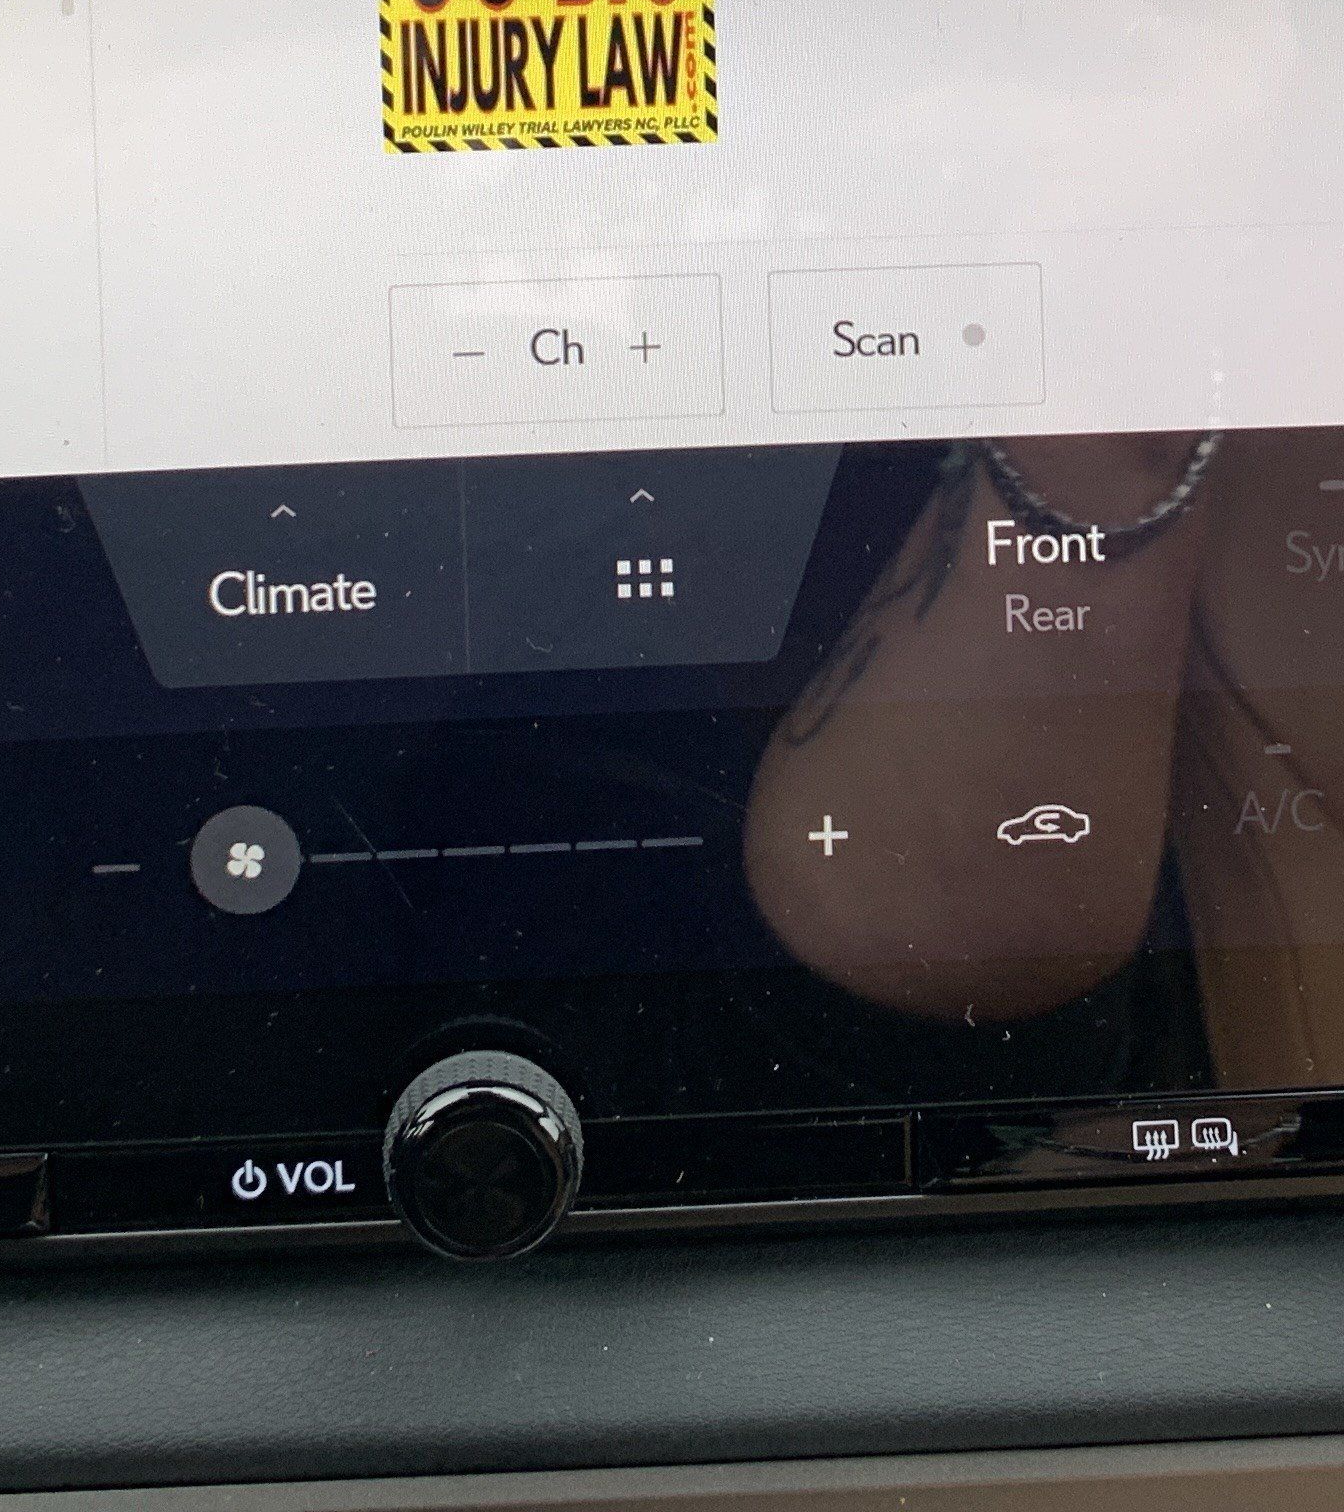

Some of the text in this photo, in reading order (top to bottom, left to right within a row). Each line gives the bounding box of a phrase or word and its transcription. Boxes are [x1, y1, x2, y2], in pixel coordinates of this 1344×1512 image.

[400, 11, 685, 116] INJURY LAW
[401, 124, 457, 138] POULIN
[461, 122, 516, 137] WILLEY
[518, 120, 559, 135] TRIAL
[563, 118, 632, 133] LAWYERS
[664, 116, 702, 130] PLLC
[530, 328, 584, 366] Ch
[833, 320, 919, 358] Scan
[986, 519, 1106, 567] Front
[209, 570, 377, 618] Climate
[1004, 593, 1091, 634] Rear
[1234, 789, 1325, 836] A/C
[277, 1160, 357, 1196] VOL
